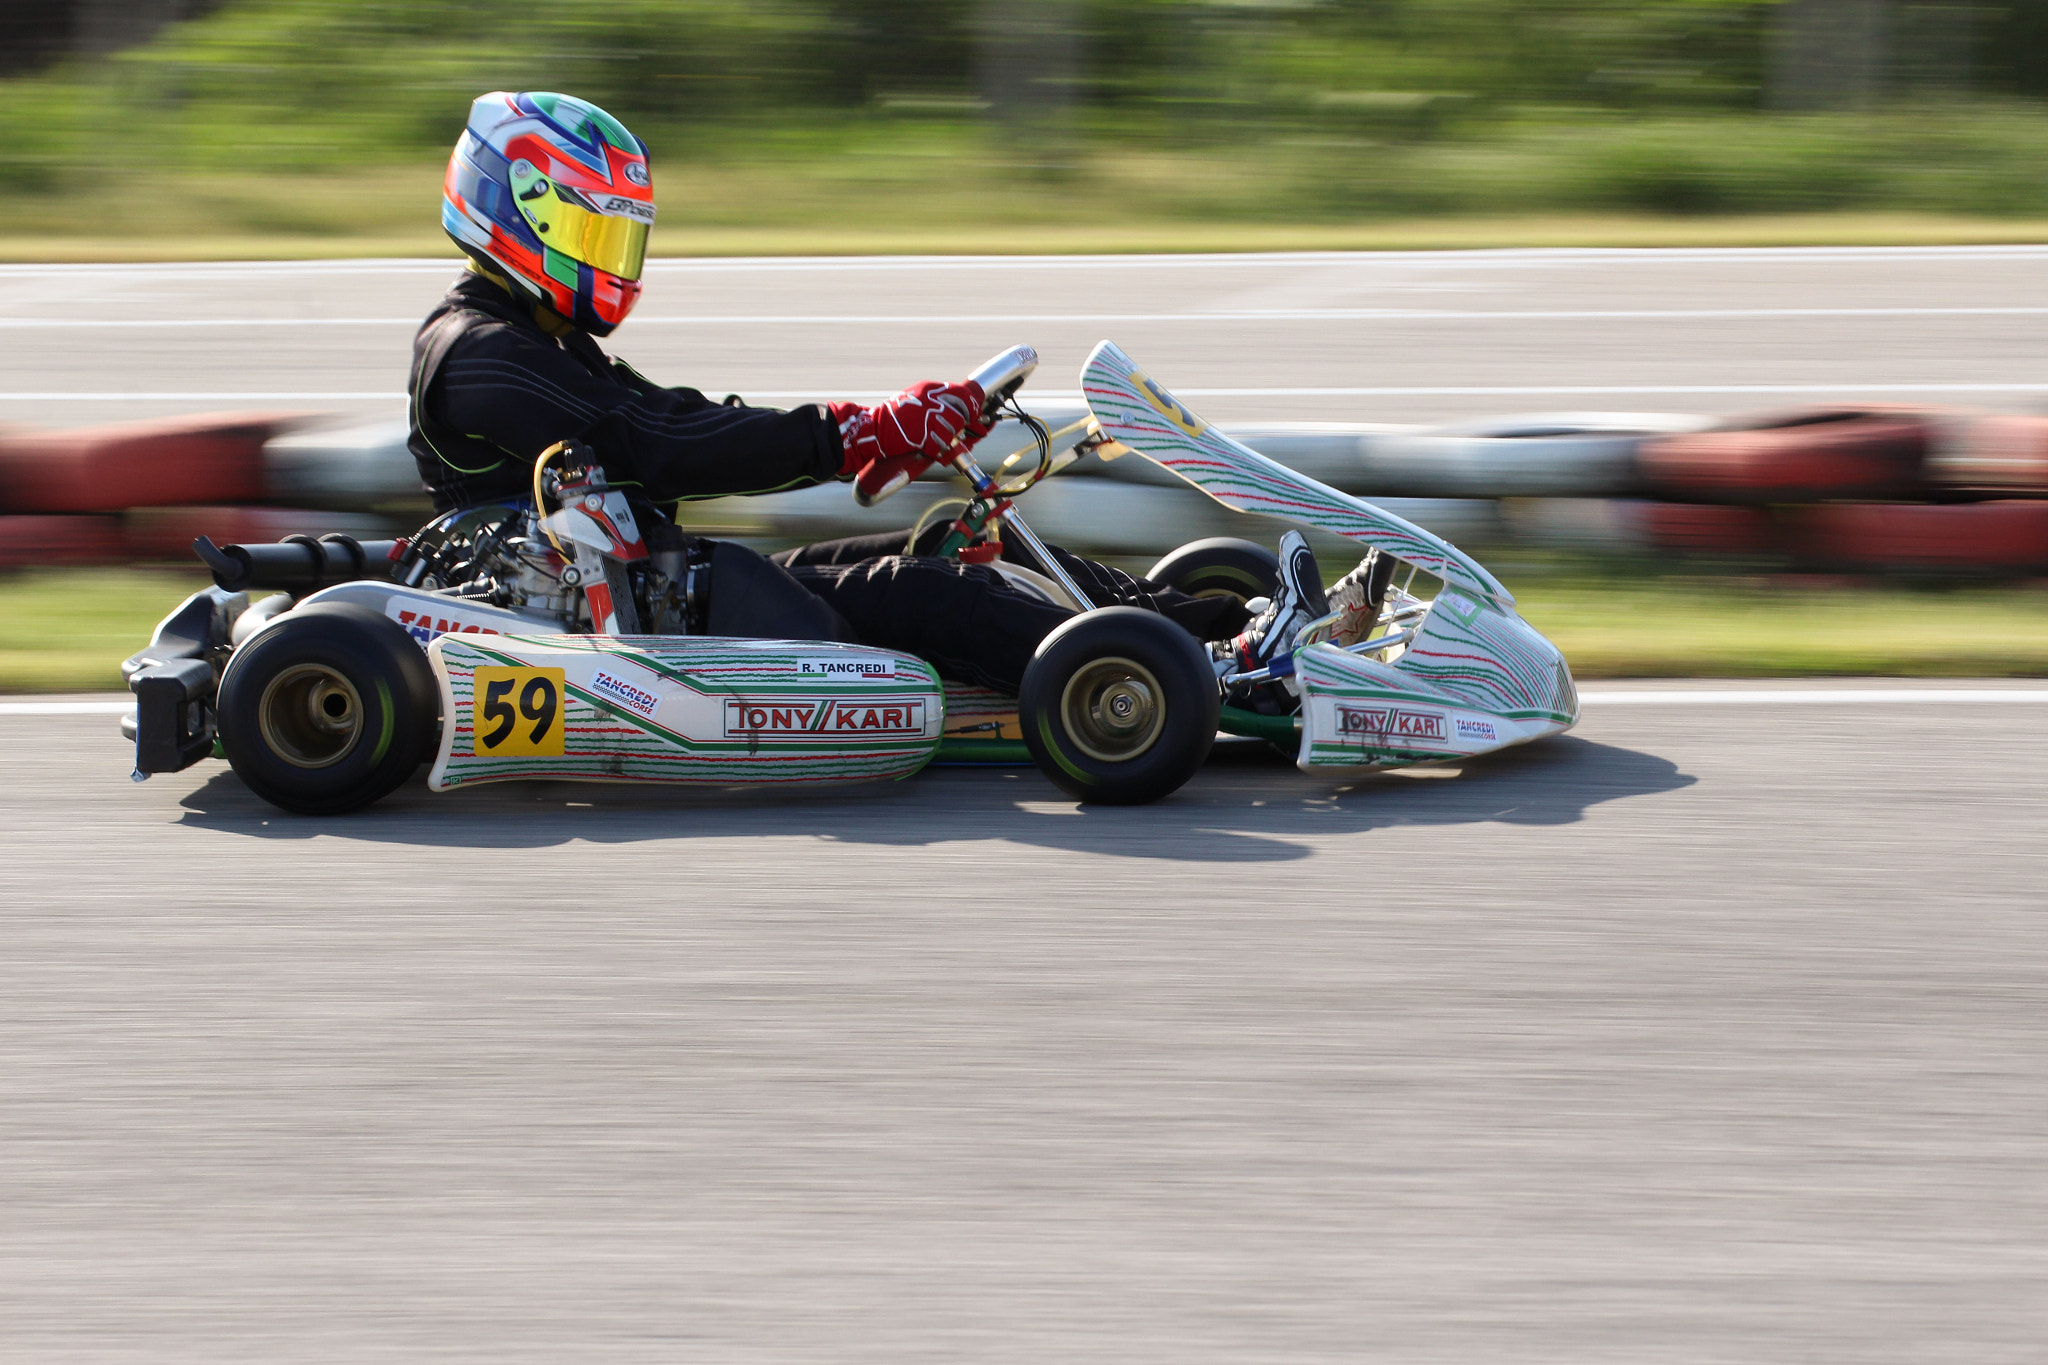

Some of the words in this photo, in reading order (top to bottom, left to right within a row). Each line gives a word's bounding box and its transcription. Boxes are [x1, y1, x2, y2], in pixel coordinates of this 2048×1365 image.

[802, 663, 815, 673] R.
[819, 663, 886, 674] TANCREDI
[596, 672, 658, 708] TANCREDI
[482, 676, 557, 749] 59
[629, 700, 653, 715] CORSE
[1456, 719, 1495, 734] TANCREDI
